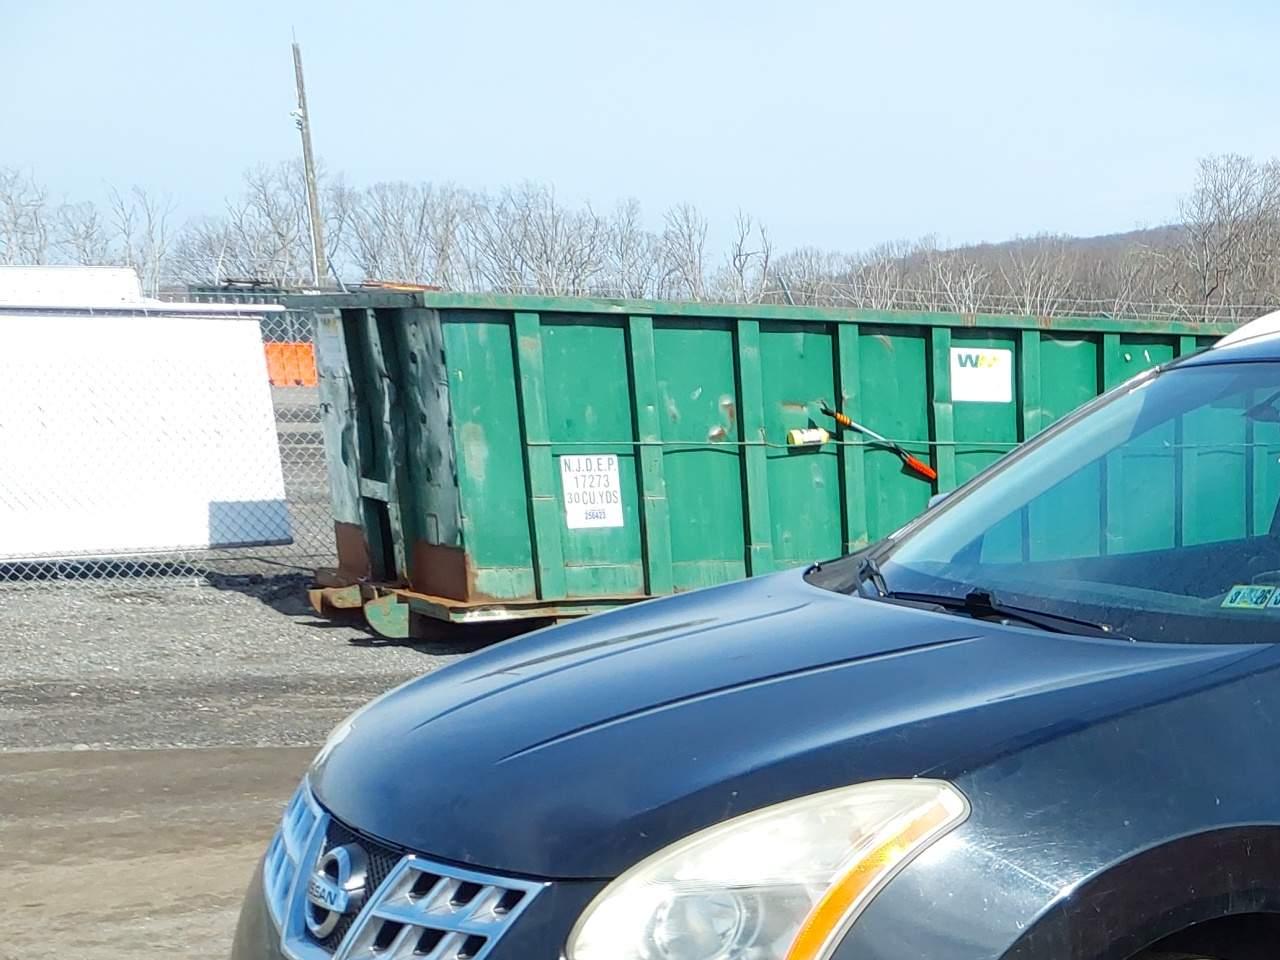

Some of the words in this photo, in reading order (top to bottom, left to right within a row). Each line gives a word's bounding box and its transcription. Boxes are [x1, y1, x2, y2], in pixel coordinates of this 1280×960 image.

[563, 457, 617, 473] N.J.D.E.P.
[573, 474, 610, 489] 17273
[308, 882, 338, 906] SSAN
